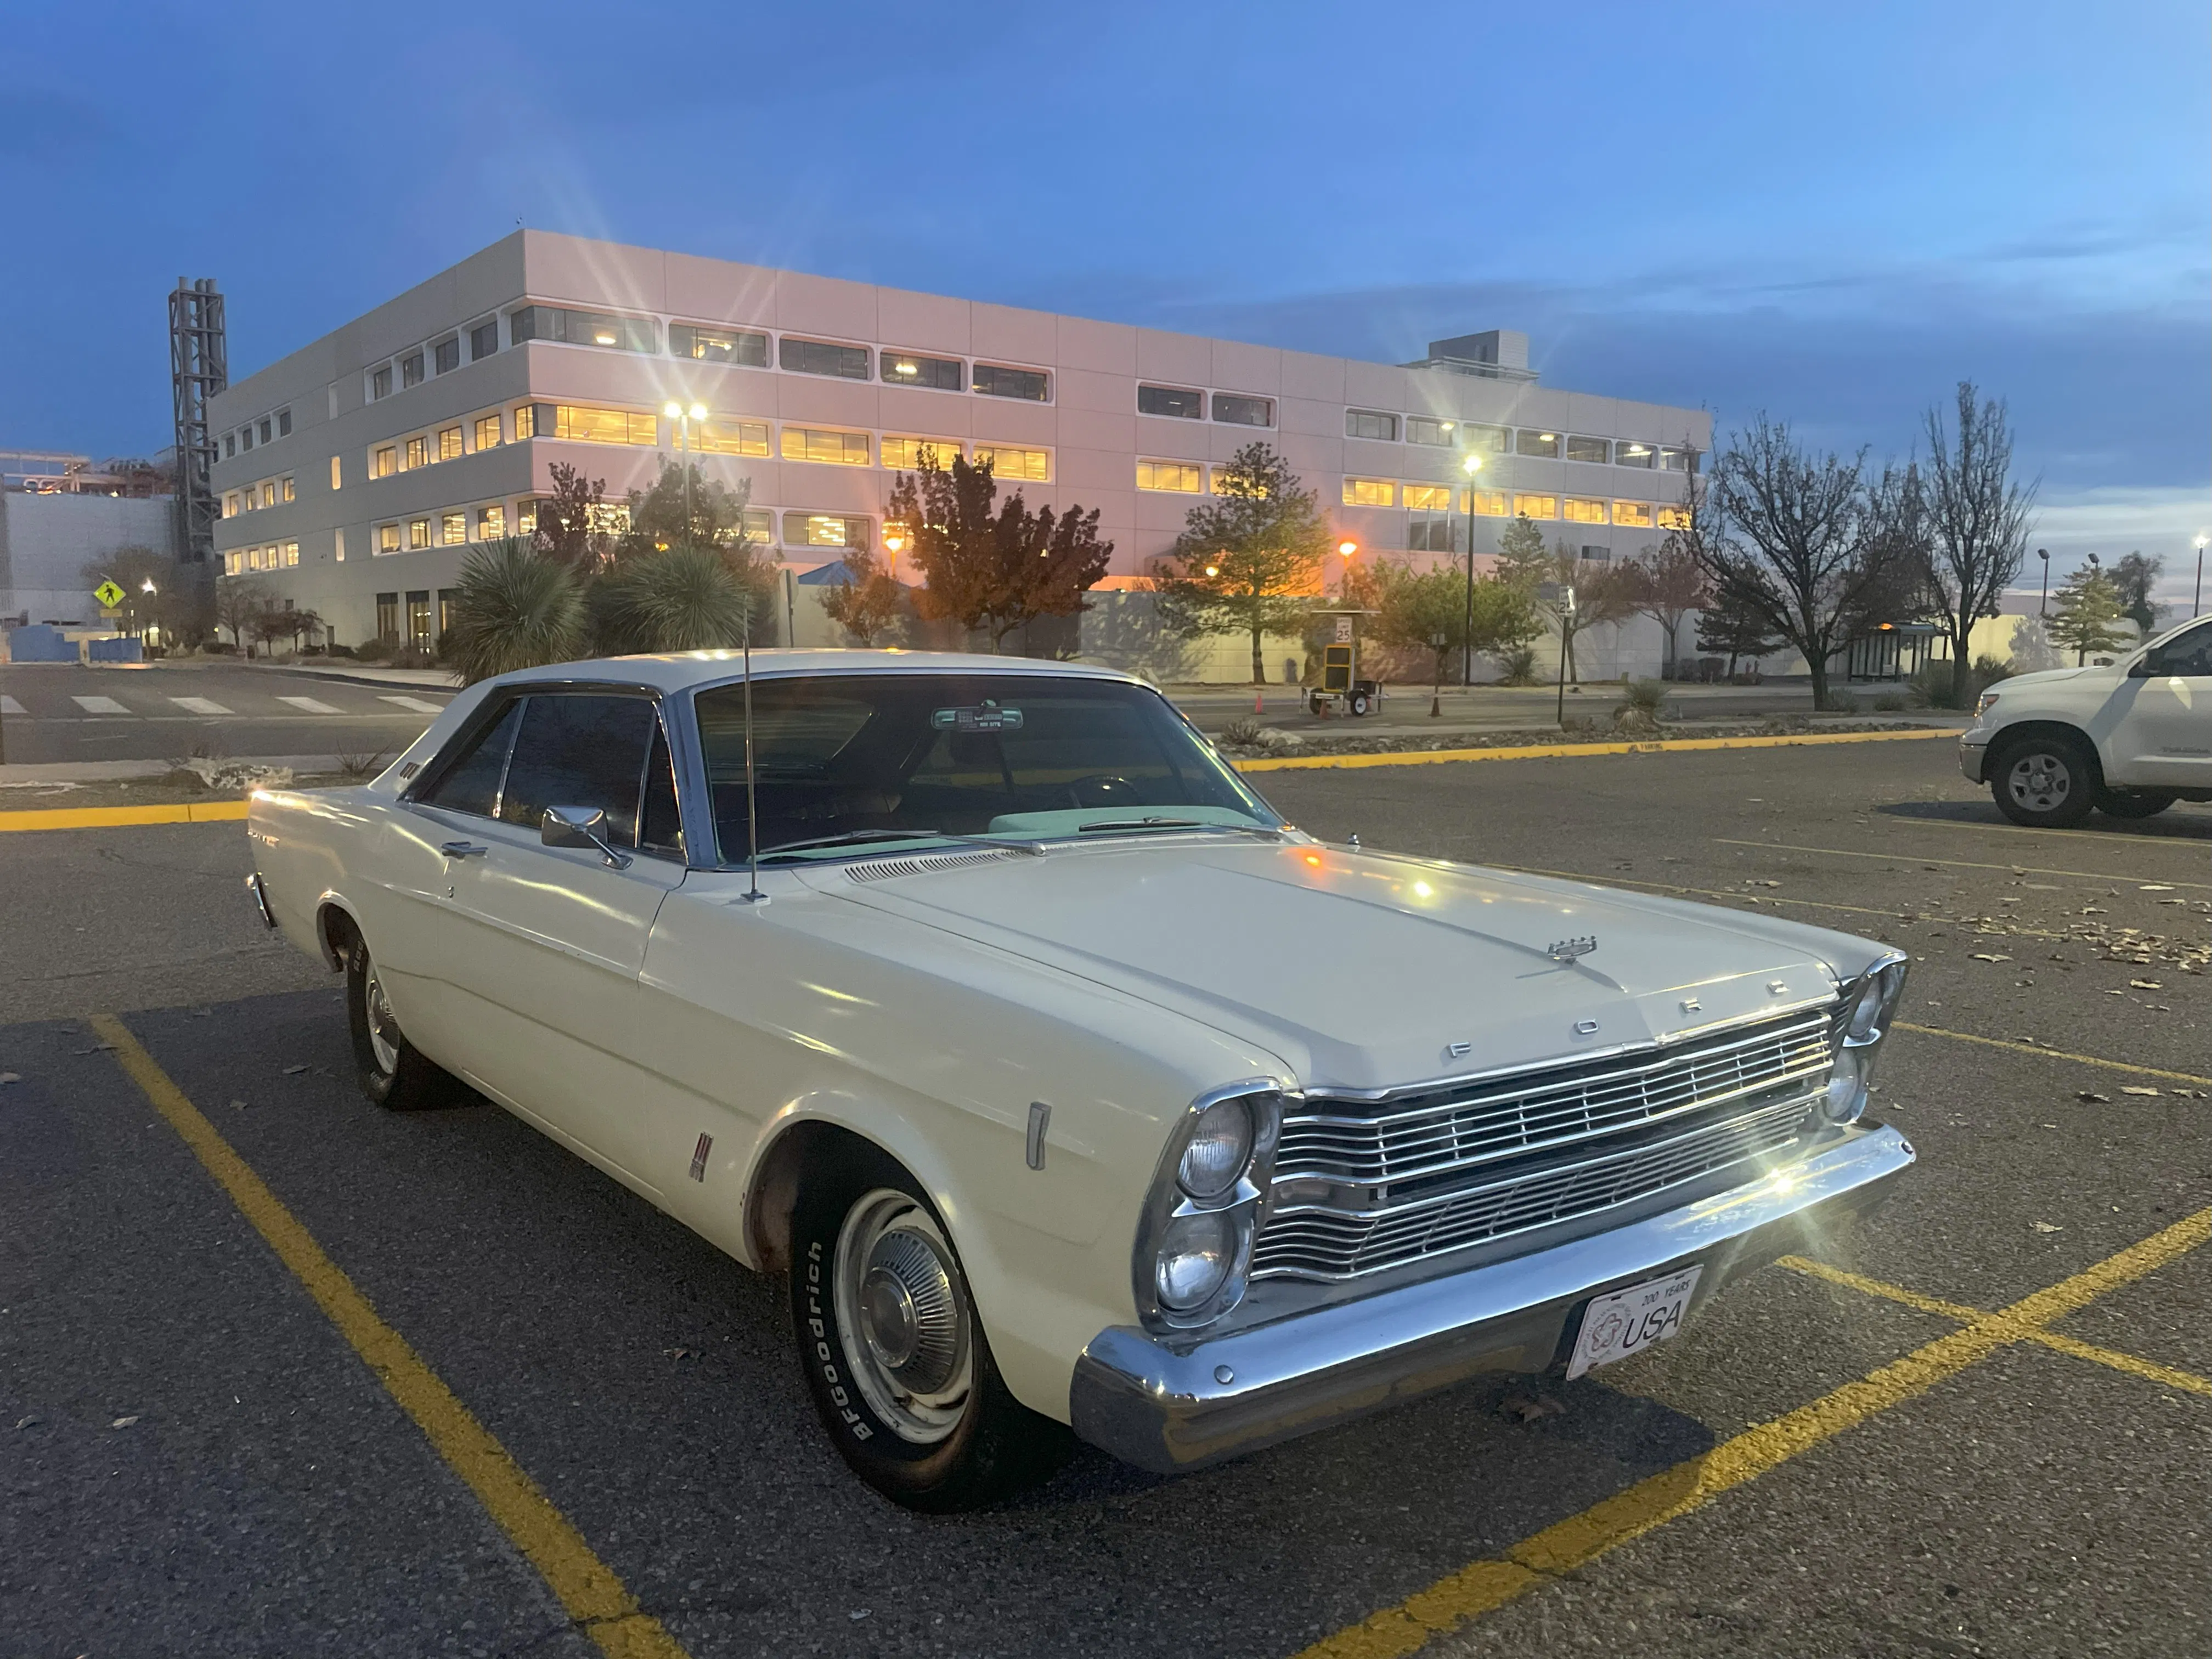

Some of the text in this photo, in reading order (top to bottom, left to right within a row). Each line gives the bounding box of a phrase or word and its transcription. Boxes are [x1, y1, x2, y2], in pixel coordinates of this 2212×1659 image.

[1337, 630, 1350, 640] 25
[1450, 980, 1789, 1058] FORD
[1641, 1279, 1691, 1306] 200 YEARS
[806, 1242, 874, 1441] BFGoodrich
[1622, 1300, 1681, 1348] USA
